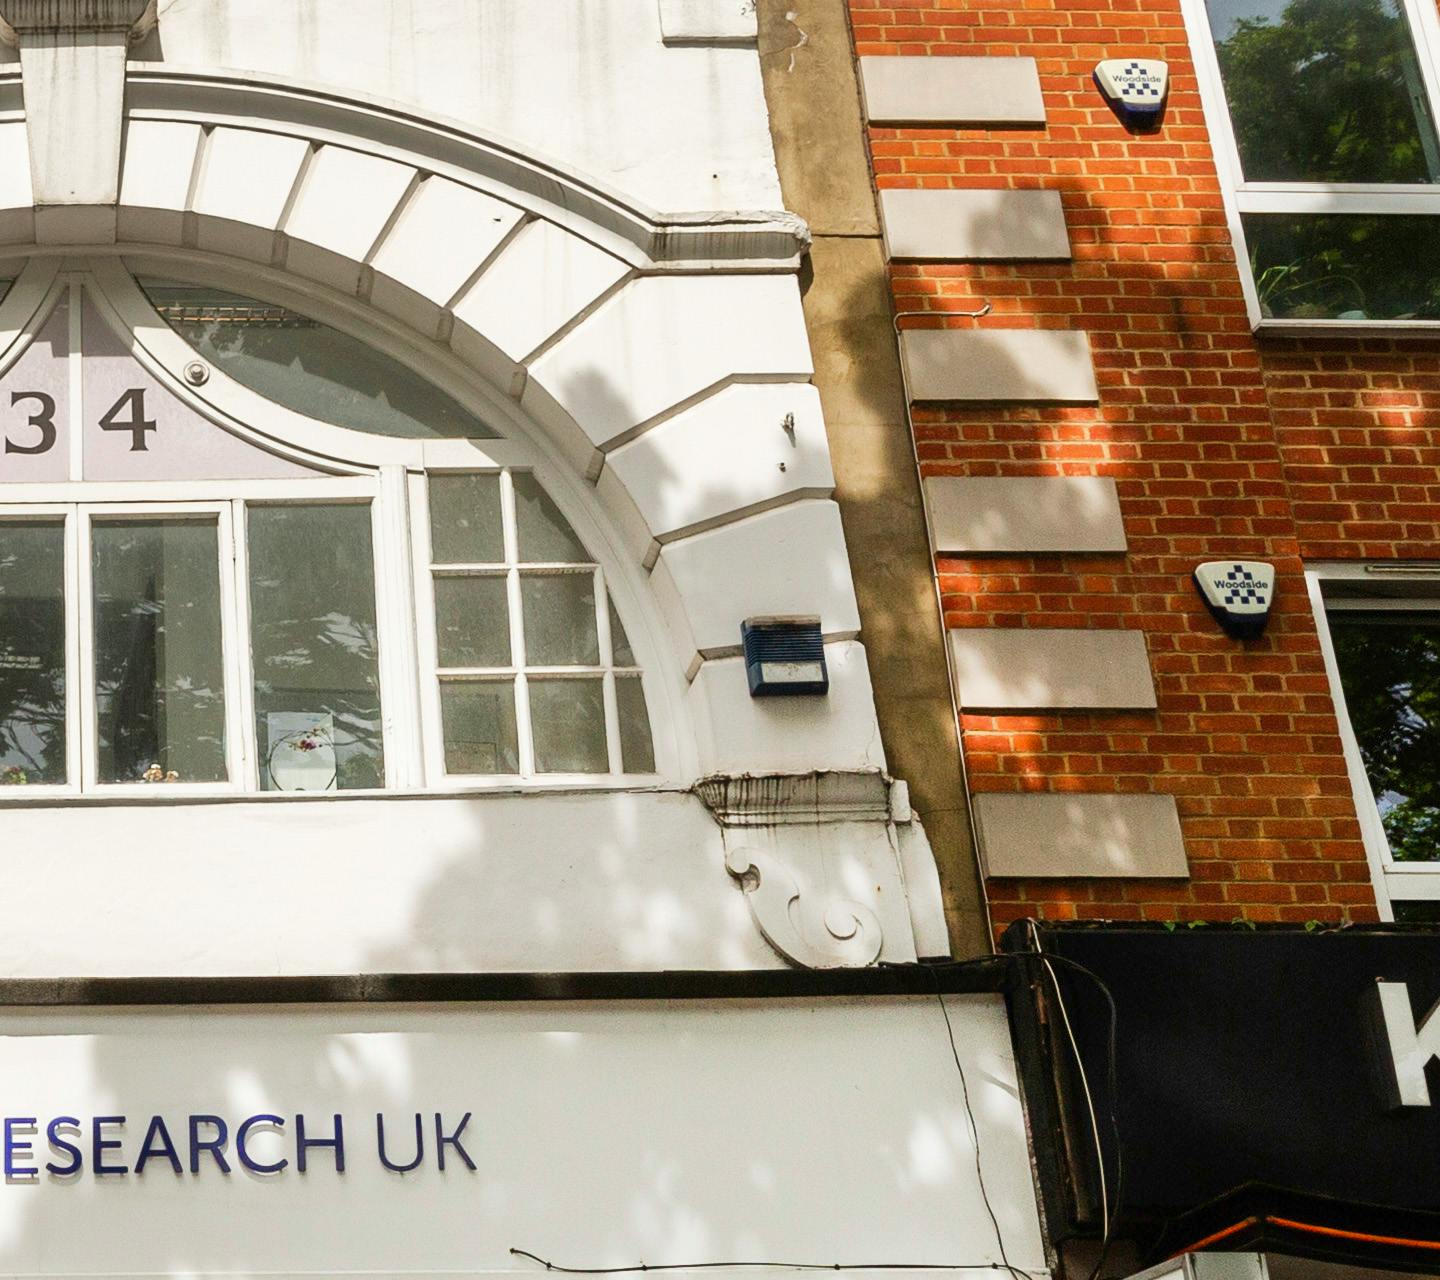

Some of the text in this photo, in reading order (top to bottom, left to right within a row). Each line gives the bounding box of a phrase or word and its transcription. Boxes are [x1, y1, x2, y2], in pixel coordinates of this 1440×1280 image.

[1112, 75, 1162, 83] Woodside
[1213, 579, 1268, 589] Woodside
[375, 1111, 478, 1174] UK
